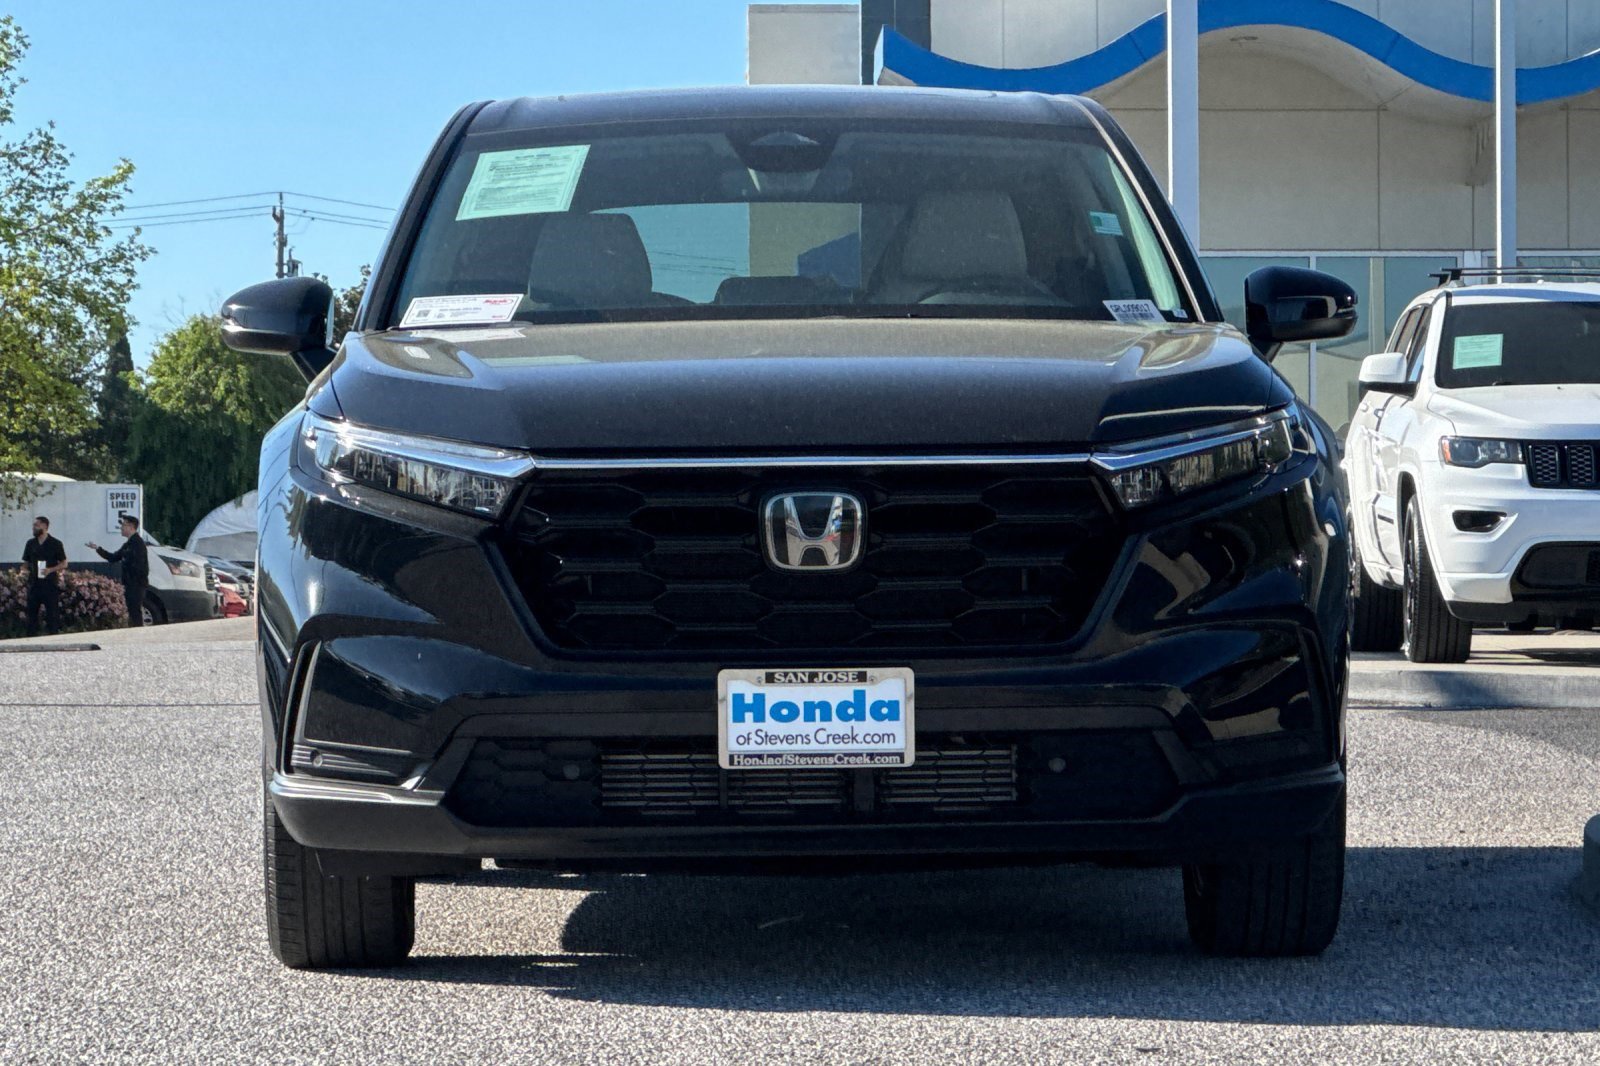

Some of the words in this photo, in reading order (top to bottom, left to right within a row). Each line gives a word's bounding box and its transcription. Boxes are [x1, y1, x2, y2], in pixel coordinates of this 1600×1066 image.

[110, 492, 136, 500] SPEED
[111, 501, 134, 509] LIMIT
[774, 671, 809, 683] SAN
[814, 671, 859, 682] JOSE
[732, 689, 900, 723] Honda
[736, 731, 752, 746] of
[754, 728, 811, 746] Stevens
[814, 726, 896, 745] Creek.com
